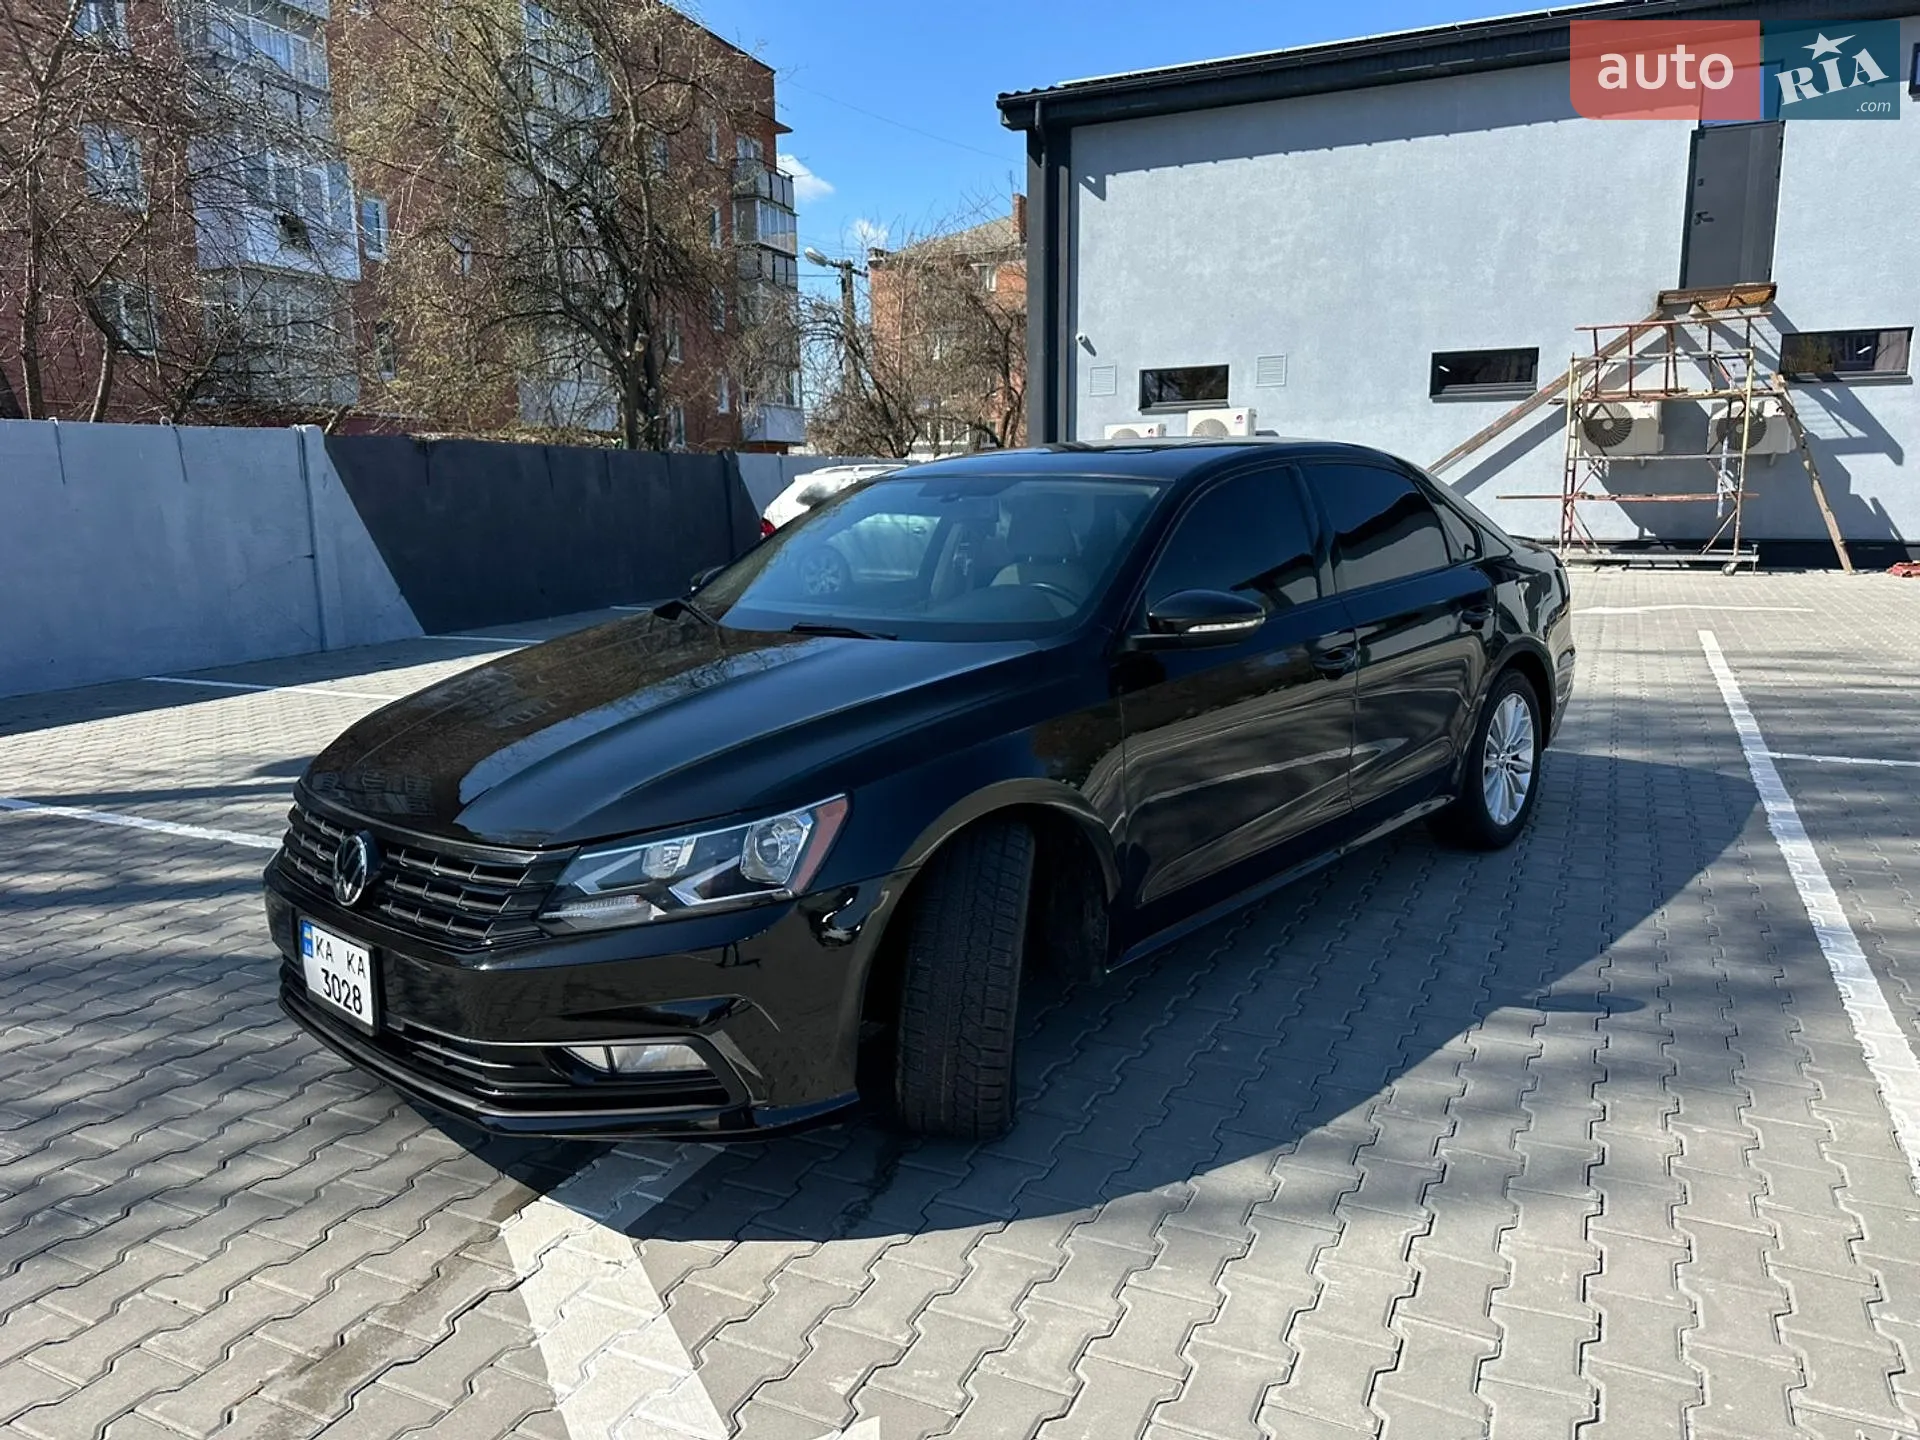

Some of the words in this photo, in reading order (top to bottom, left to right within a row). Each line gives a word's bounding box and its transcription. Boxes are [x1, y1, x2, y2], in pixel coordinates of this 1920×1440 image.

[315, 935, 334, 963] KA
[346, 950, 367, 979] KA
[321, 967, 363, 1015] 3028
